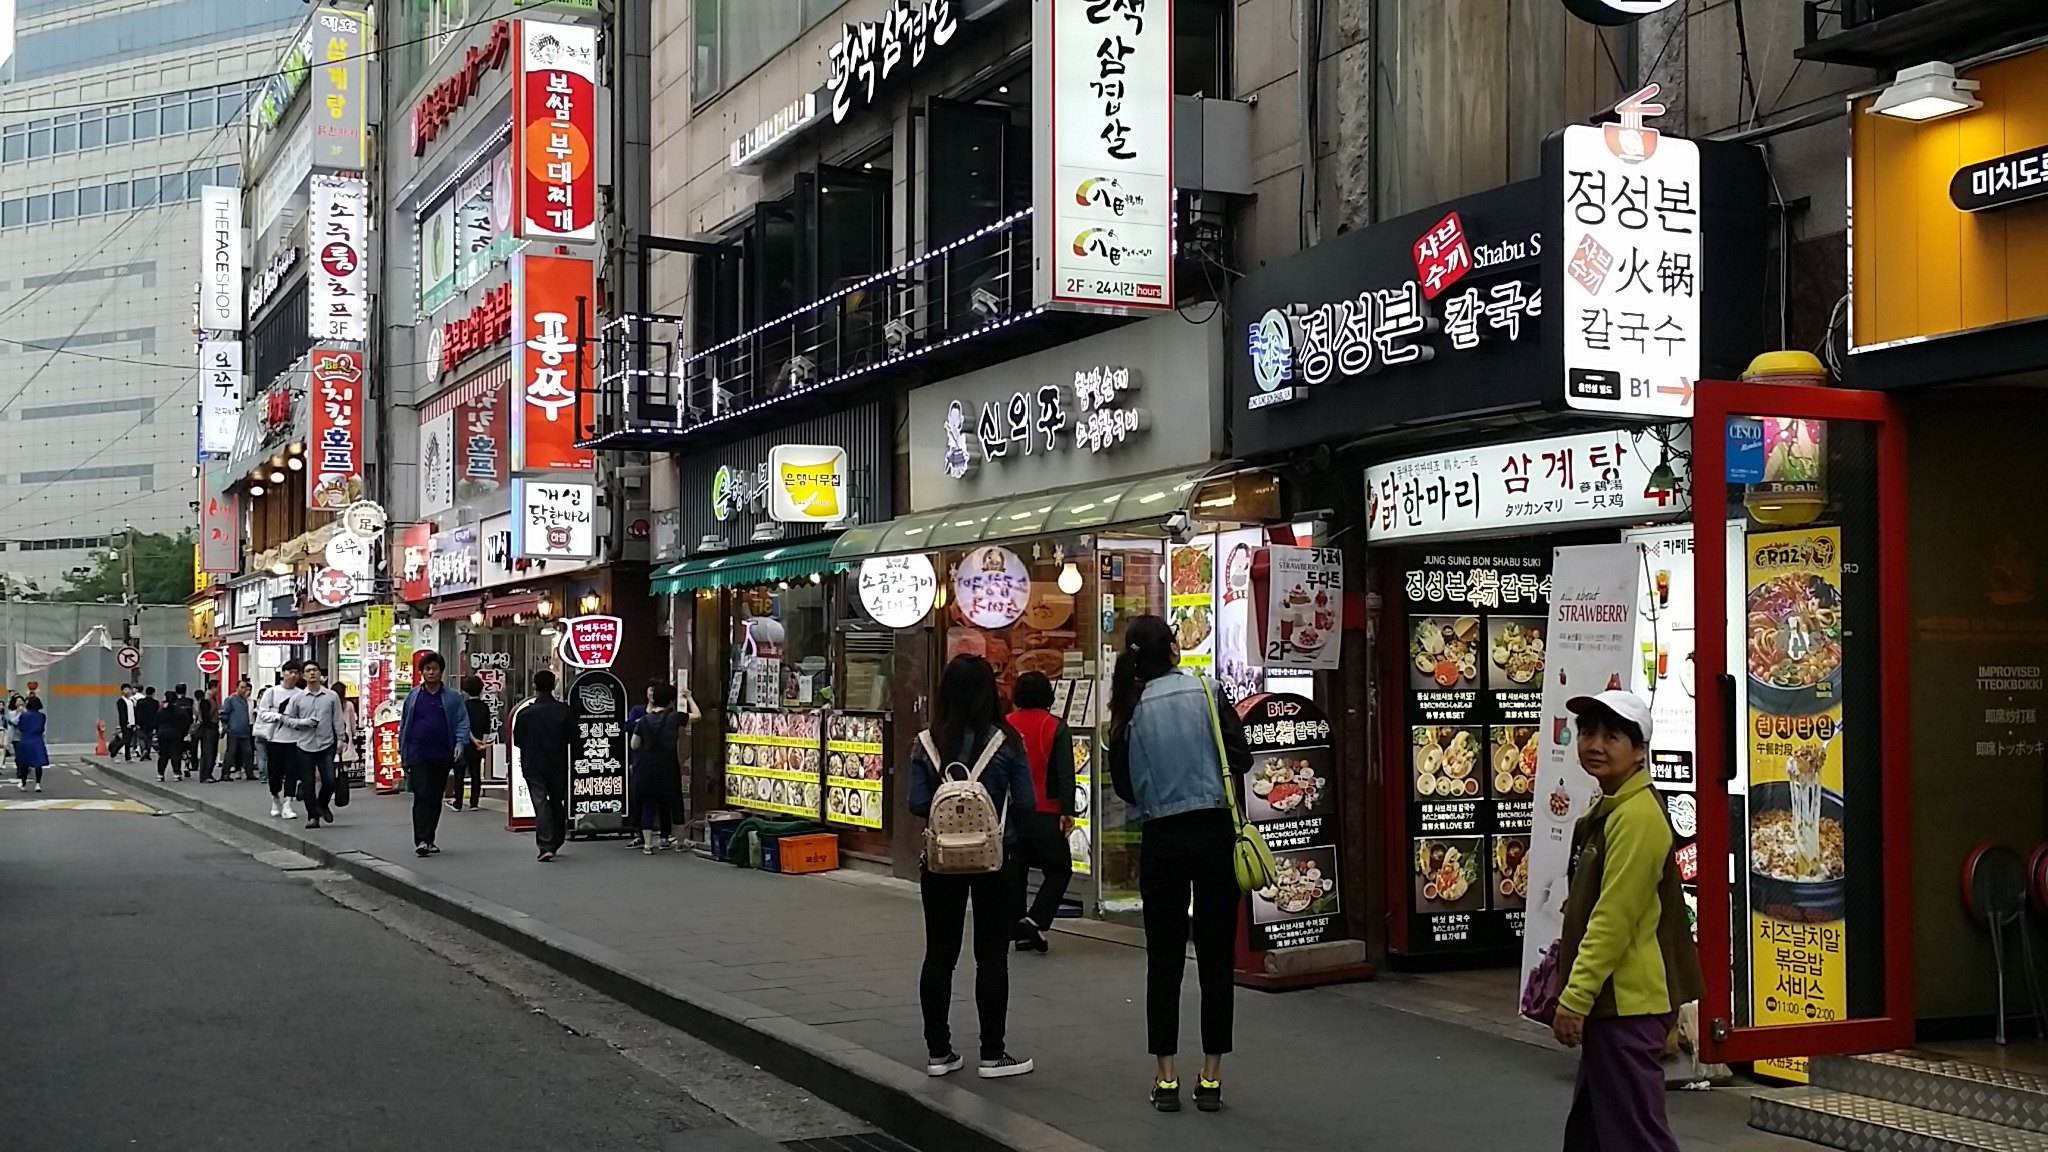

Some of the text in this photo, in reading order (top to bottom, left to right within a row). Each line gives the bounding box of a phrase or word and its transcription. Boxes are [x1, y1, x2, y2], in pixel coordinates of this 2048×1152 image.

[1089, 35, 1138, 161] 삼겹살
[545, 72, 575, 232] 보쌈 부대찌개
[1092, 187, 1126, 217] 八色
[1566, 168, 1697, 235] 정성본
[1089, 237, 1122, 267] 八色
[1416, 217, 1462, 266] 샤브
[214, 199, 231, 320] THEFACESHOP
[1472, 242, 1526, 270] Shabu
[1577, 236, 1613, 274] 샤브
[1423, 248, 1471, 292] 수끼
[1569, 256, 1602, 295] 수끼
[1614, 245, 1695, 299] 火锅
[1066, 277, 1162, 298] 2F 24시간 hours
[329, 320, 348, 335] 3F
[1298, 279, 1426, 386] 정성본
[1580, 307, 1687, 357] 칼국수
[1630, 377, 1650, 399] B1
[977, 384, 1067, 463] 신의주
[1729, 423, 1762, 440] CESCO
[784, 472, 842, 487] 은행나무집
[1501, 442, 1628, 494] 삼계탕
[537, 488, 582, 506] 개성
[1381, 471, 1481, 531] 닭한마리
[1573, 492, 1624, 510] 一只鸡
[528, 503, 590, 527] 닭한마리
[1311, 548, 1341, 566] 카페
[1423, 555, 1541, 567] JUNG SUNG BON SHABU SUKI
[862, 571, 933, 594] 소곱창구이
[1305, 570, 1342, 590] 두다트
[1405, 570, 1467, 602] 정성본
[1467, 568, 1499, 588] 샤브
[1467, 588, 1499, 608] 수끼
[1558, 604, 1630, 623] STRAWBERRY
[579, 632, 613, 643] coffee
[1267, 640, 1293, 661] 2F
[1978, 665, 2040, 678] IMPROVISED
[1976, 678, 2043, 691] TTEOKBOKKI
[1266, 701, 1285, 718] B1
[1295, 719, 1330, 741] 칼국수
[1756, 715, 1833, 738] 런치타임
[574, 758, 622, 775] 칼국수
[573, 775, 623, 796] 24시간영업
[1431, 914, 1471, 925] 버섯 칼국수
[1759, 919, 1841, 953] 치즈날치알
[1775, 946, 1824, 977] 볶음밥
[1776, 974, 1825, 1001] 서비스
[1776, 1000, 1835, 1022] 11:00 2:00
